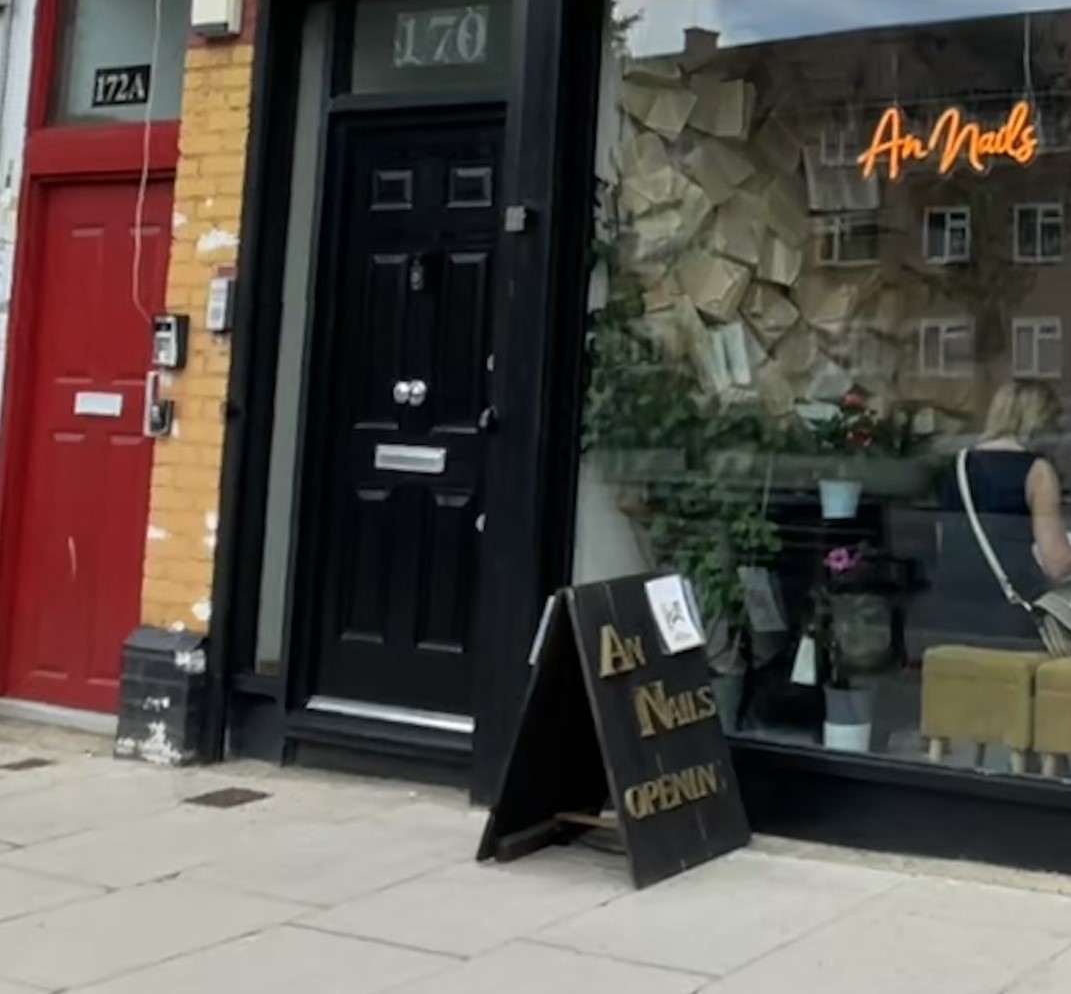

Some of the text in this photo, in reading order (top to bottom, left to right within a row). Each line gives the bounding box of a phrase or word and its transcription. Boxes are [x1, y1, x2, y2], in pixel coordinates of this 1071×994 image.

[394, 10, 488, 68] 170
[95, 72, 146, 103] 172A
[857, 100, 1039, 180] An Nails
